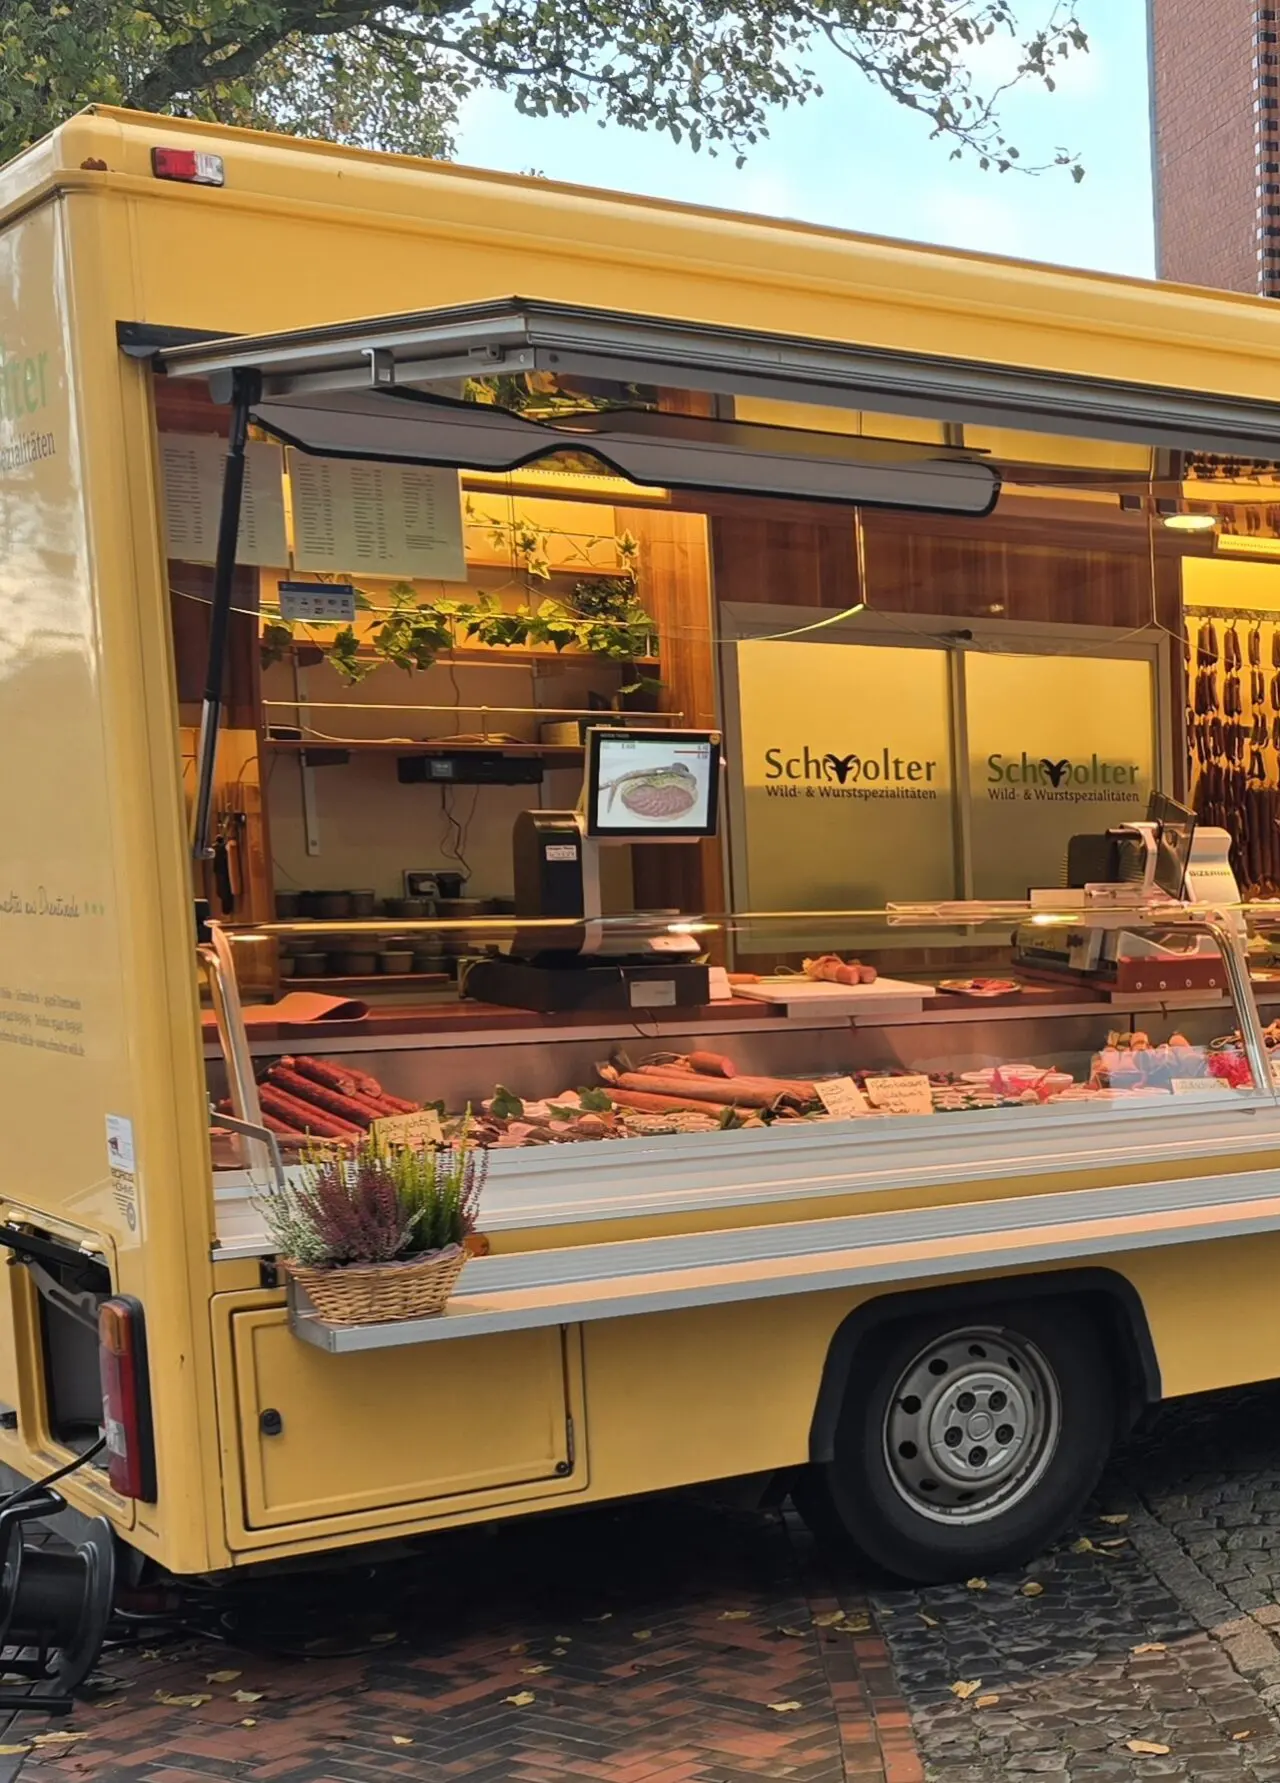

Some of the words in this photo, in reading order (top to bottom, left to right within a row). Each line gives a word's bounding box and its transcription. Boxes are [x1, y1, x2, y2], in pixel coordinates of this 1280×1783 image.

[765, 785, 800, 798] Wild-
[806, 786, 815, 798] &
[819, 786, 937, 801] Wurstspezialitäten
[988, 788, 1019, 800] Wild-
[1024, 789, 1032, 801] &
[1034, 788, 1139, 803] Wurstspezialitäten
